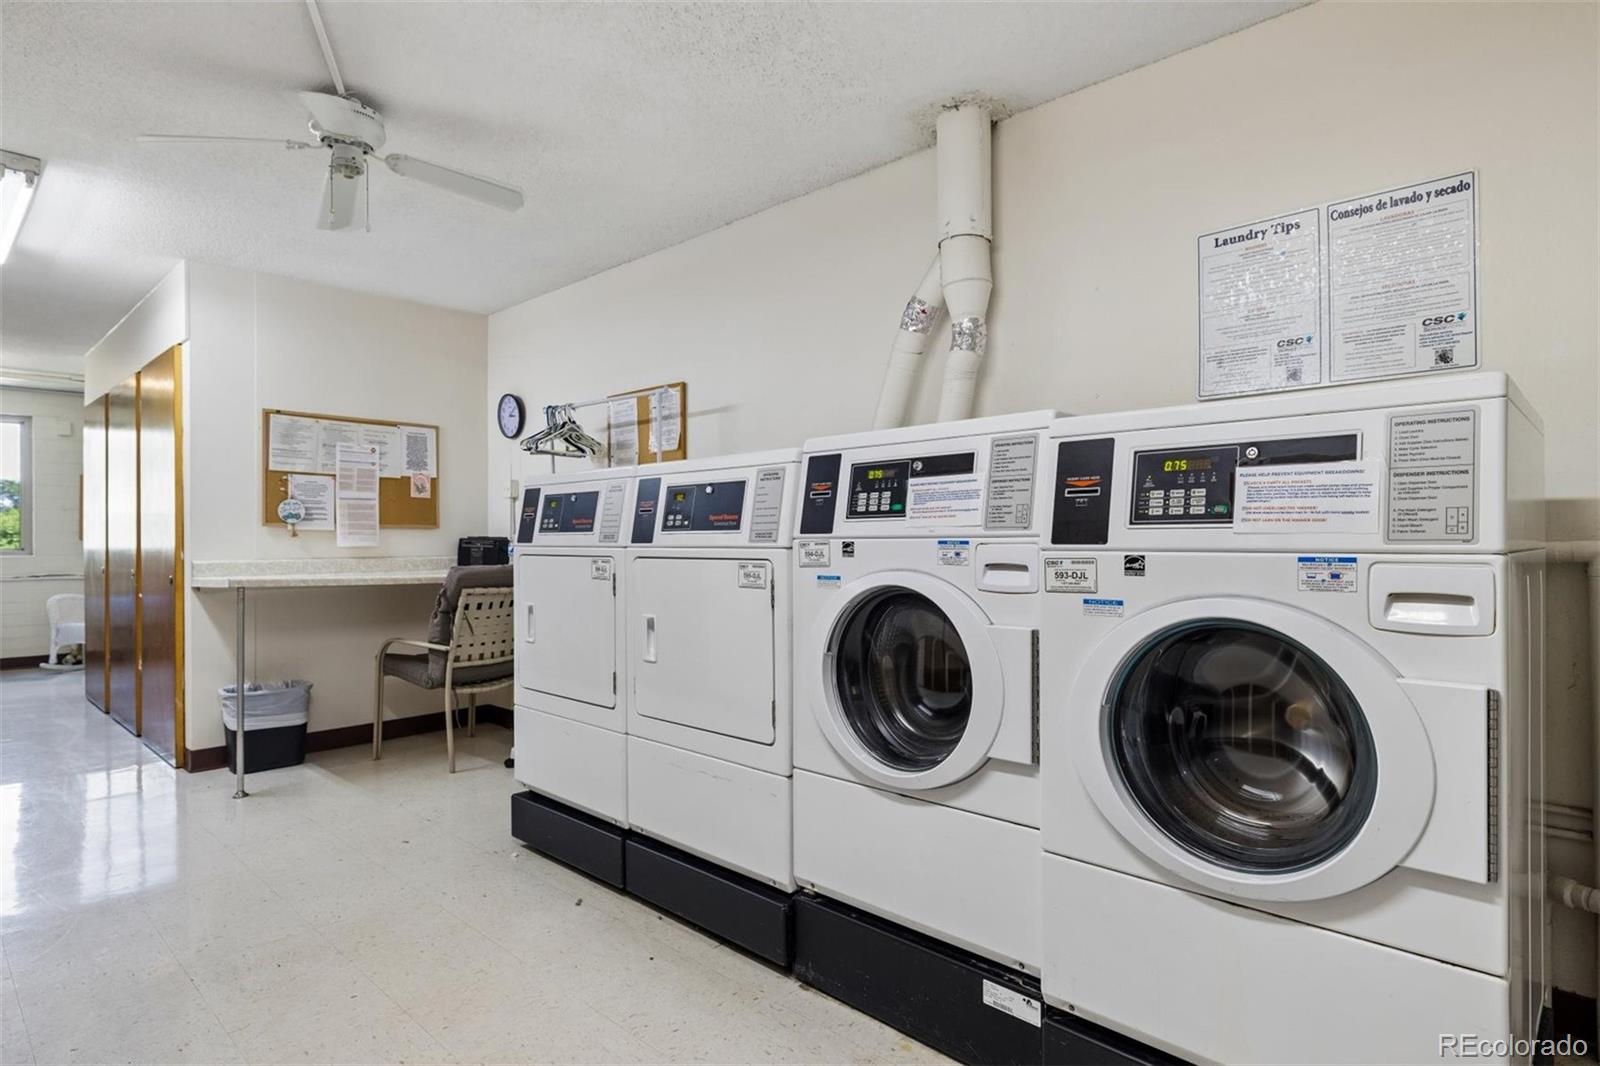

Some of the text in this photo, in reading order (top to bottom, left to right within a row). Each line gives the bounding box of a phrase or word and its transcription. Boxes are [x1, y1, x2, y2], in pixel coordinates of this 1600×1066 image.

[1330, 179, 1471, 221] Consejos de lavado y secado
[1213, 229, 1268, 248] Laundry
[1270, 221, 1301, 235] Tips
[1422, 314, 1455, 327] CSC
[1277, 337, 1304, 348] CSC
[1428, 416, 1470, 424] INSTRUCTIONS
[1054, 572, 1088, 580] 593-DJL
